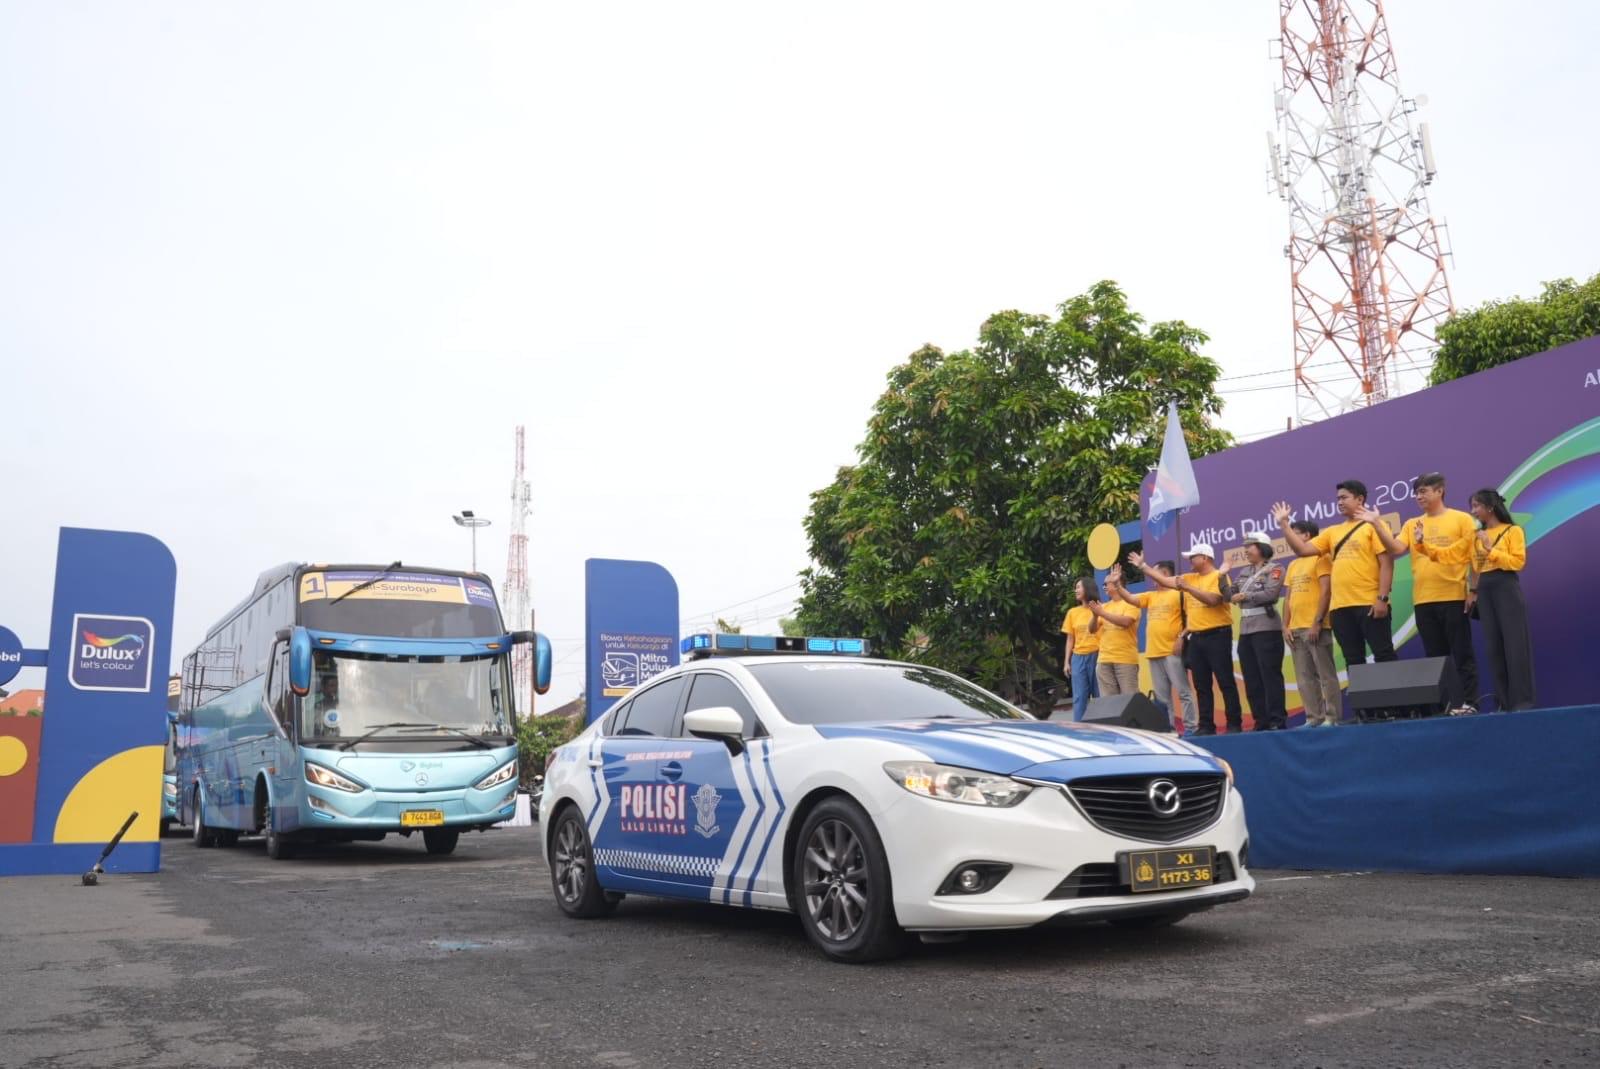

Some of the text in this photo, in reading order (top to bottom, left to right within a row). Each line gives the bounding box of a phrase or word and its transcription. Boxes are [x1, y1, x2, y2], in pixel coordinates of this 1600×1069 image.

[1190, 527, 1237, 549] Mitra
[304, 577, 324, 594] 1
[352, 582, 438, 594] Bli-Surabaya
[605, 641, 626, 650] untuk
[0, 651, 20, 662] bel
[81, 644, 135, 661] Dulux
[640, 653, 668, 663] Mitra
[80, 660, 135, 670] let's colour
[640, 662, 671, 672] Dulux
[620, 784, 686, 820] POLISI
[1177, 853, 1193, 865] XI
[1160, 869, 1210, 884] 1173-36
